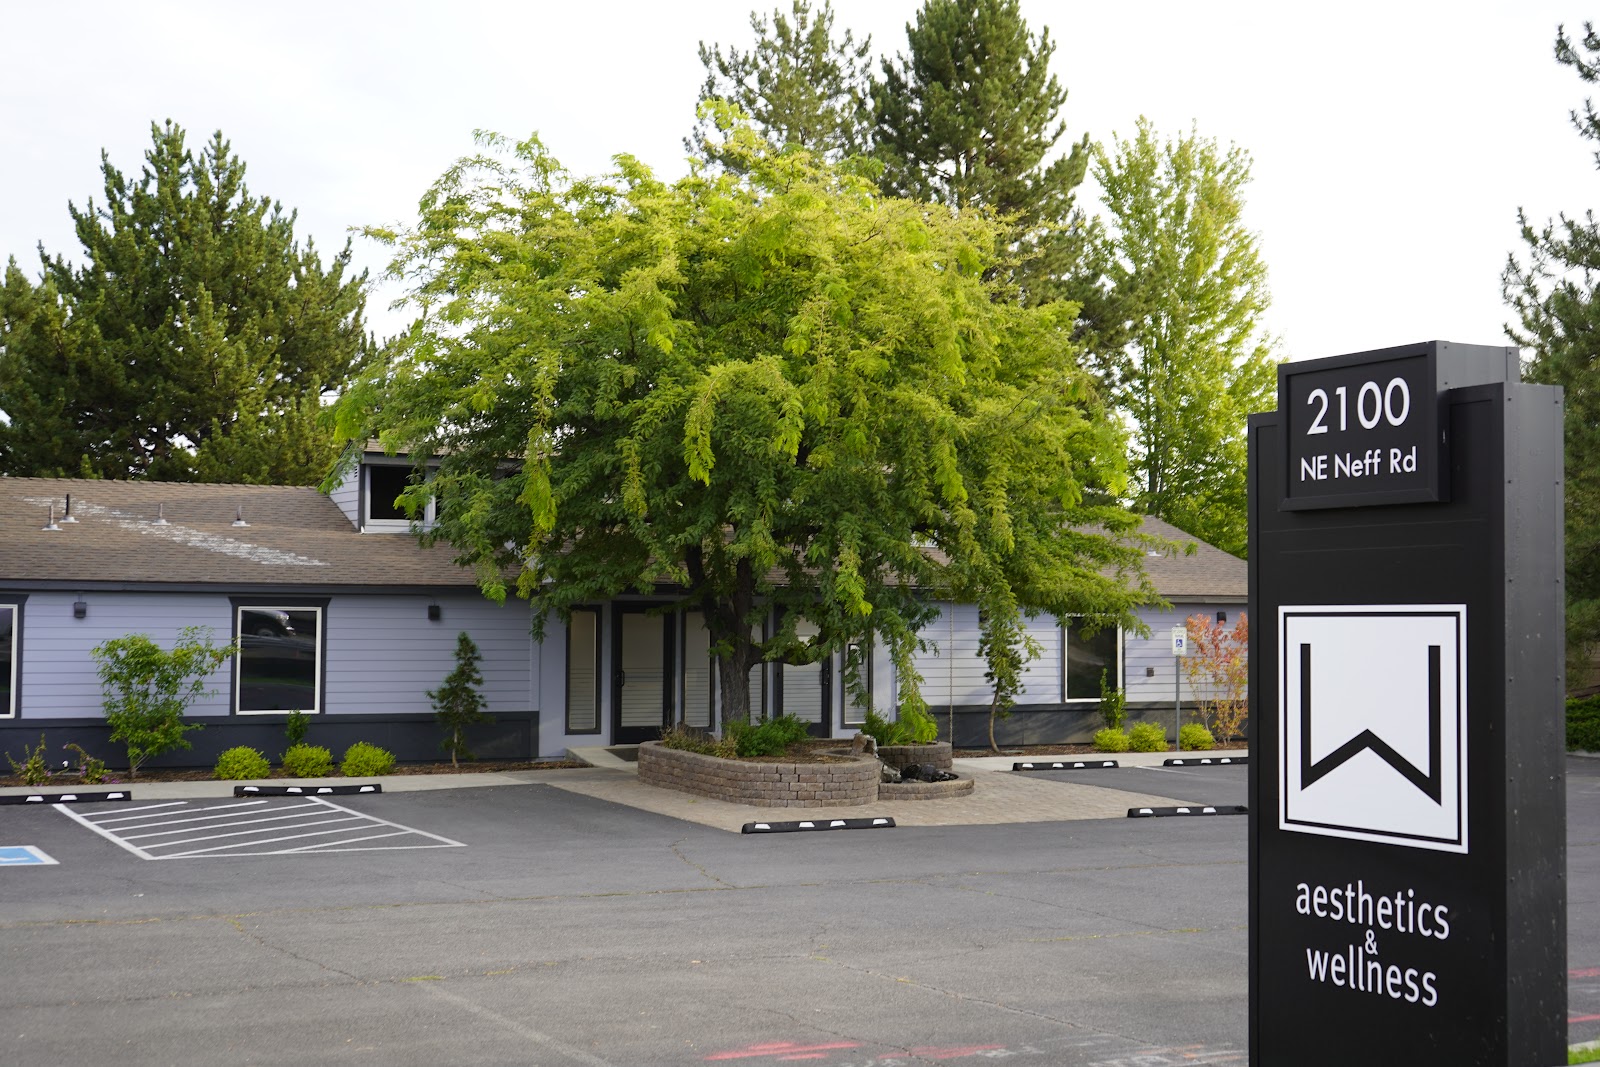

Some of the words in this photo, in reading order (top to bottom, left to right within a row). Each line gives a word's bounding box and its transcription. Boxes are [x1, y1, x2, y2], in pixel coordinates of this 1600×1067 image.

[1307, 377, 1411, 435] 2100
[1300, 455, 1328, 482] NE
[1334, 448, 1382, 479] Neff
[1389, 445, 1418, 474] Rd
[1295, 879, 1450, 940] aesthetics
[1364, 929, 1379, 956] &
[1306, 945, 1438, 1007] wellness
